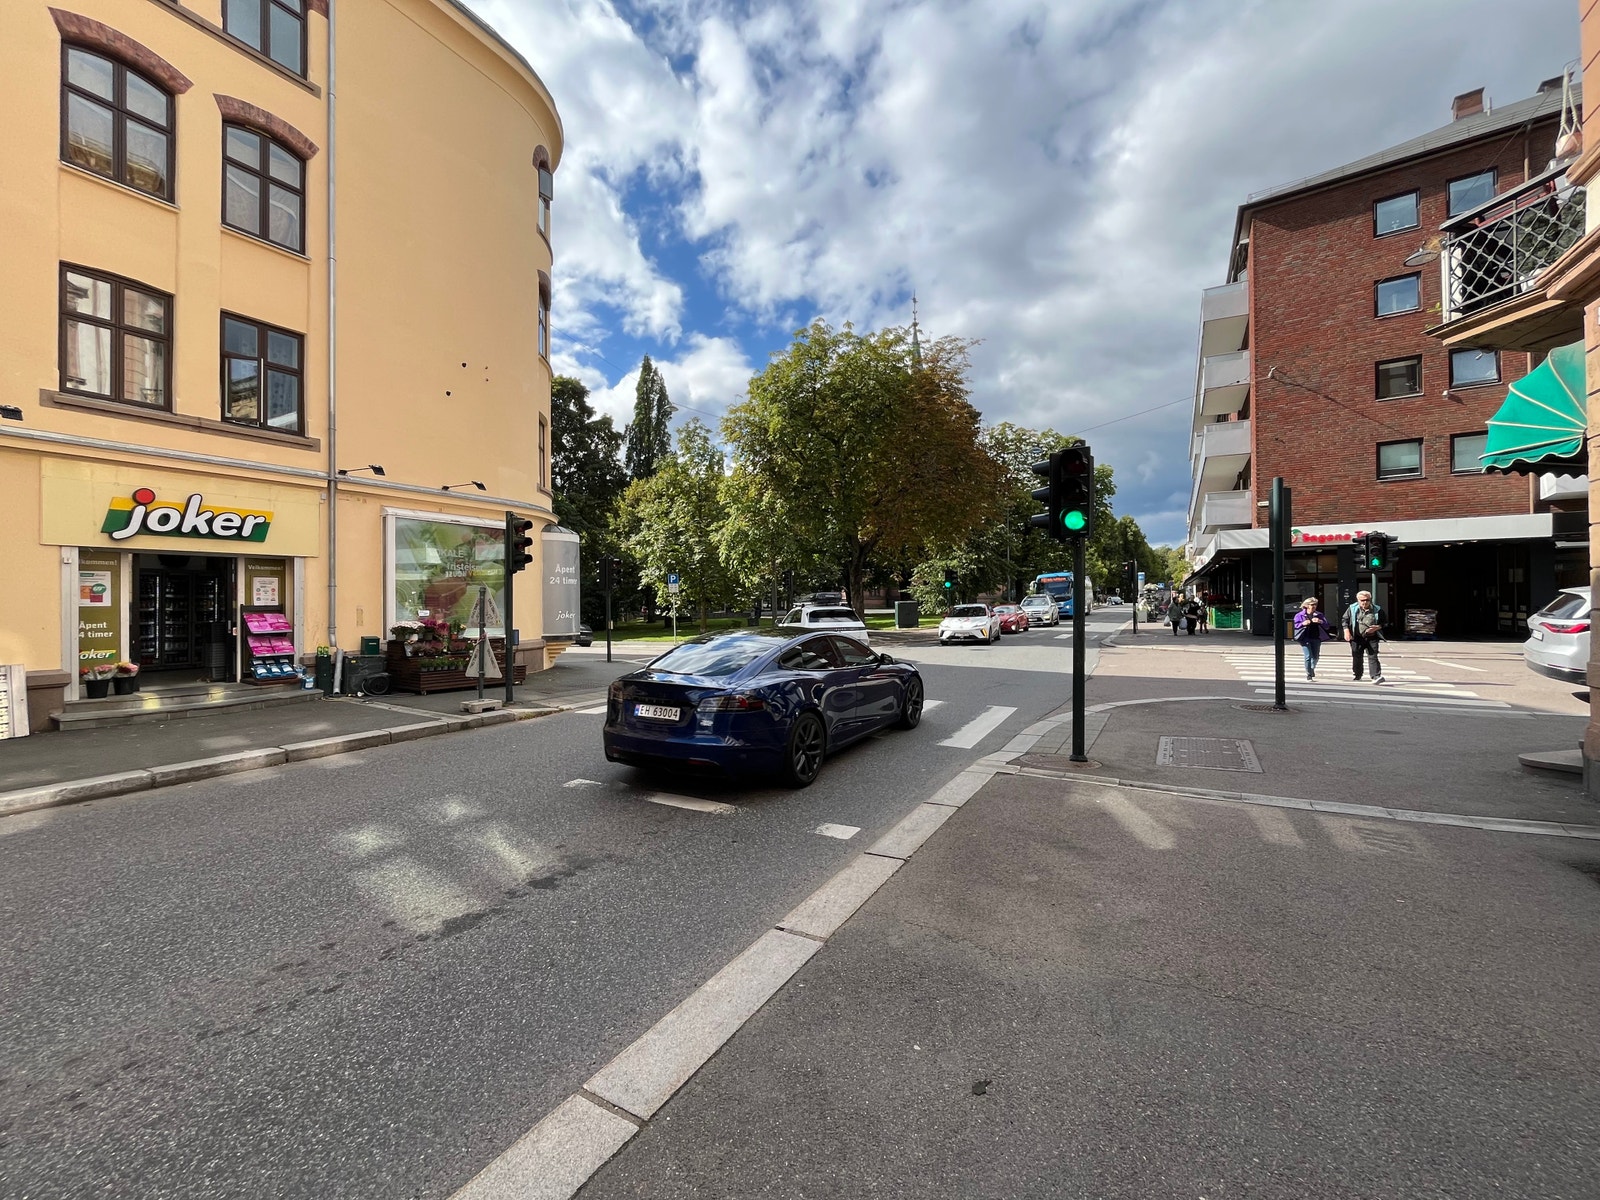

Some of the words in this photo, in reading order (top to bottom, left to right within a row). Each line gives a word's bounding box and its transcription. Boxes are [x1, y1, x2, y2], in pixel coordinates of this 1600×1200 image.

[109, 488, 266, 541] joker
[670, 575, 677, 583] P
[555, 610, 575, 620] joker
[79, 621, 107, 630] Åpent
[79, 649, 112, 660] oker
[640, 705, 650, 715] EH
[653, 707, 678, 718] 63004
